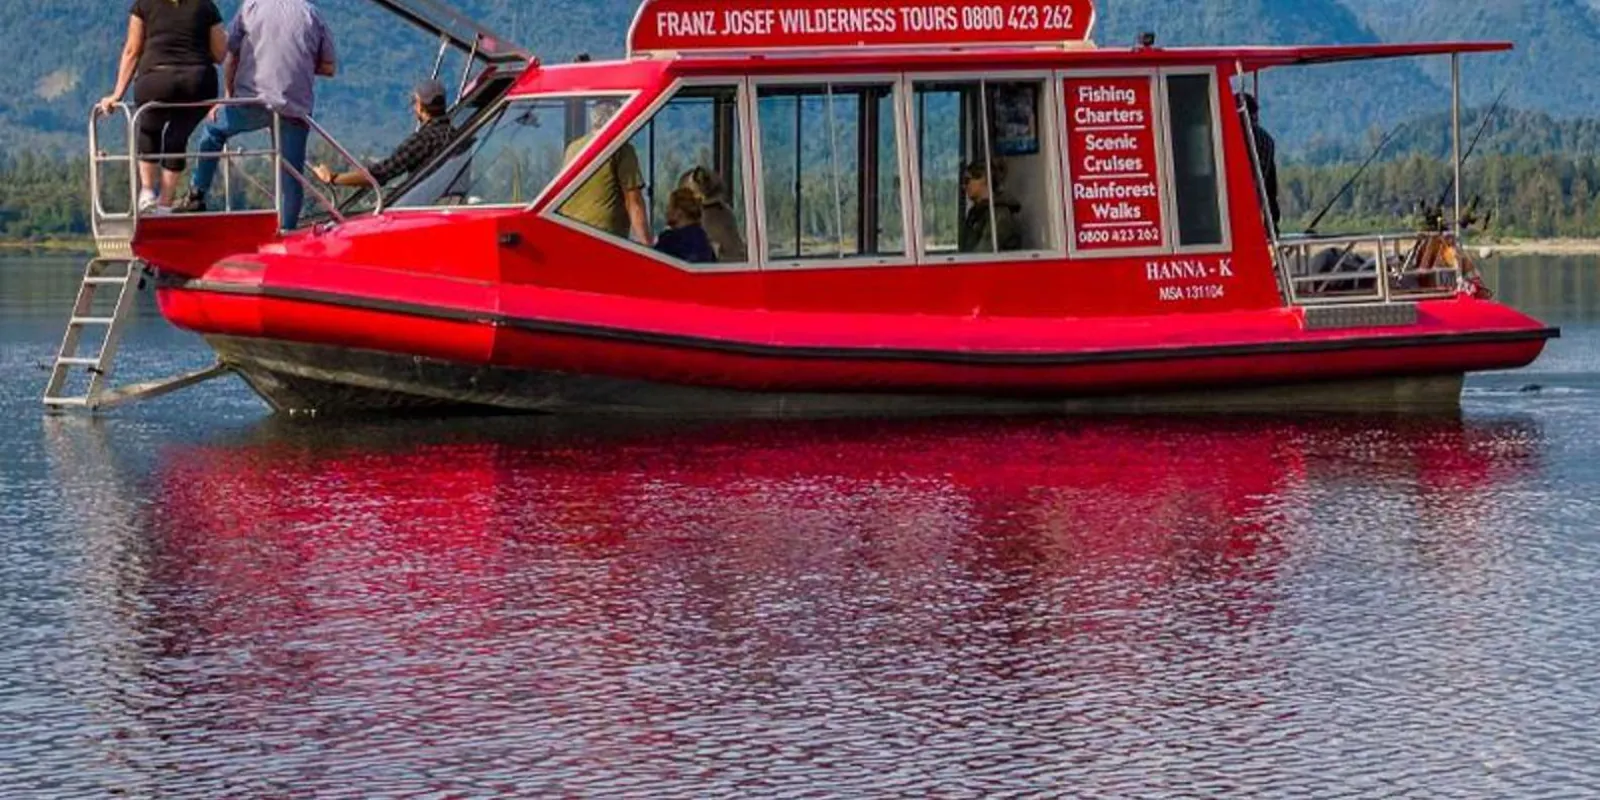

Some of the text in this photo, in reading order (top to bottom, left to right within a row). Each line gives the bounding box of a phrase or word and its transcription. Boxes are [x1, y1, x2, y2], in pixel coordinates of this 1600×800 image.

[656, 5, 1074, 37] FRANZ JOSEF WILDERNESS TOURS 0800 423 262
[1078, 86, 1136, 105] Fishing
[1074, 107, 1144, 124] Charters
[1085, 133, 1138, 151] Scenic
[1083, 155, 1143, 173] Cruises
[1073, 181, 1157, 200] Rainforest
[1091, 202, 1141, 220] Walks
[1079, 228, 1160, 243] 0800 423 262
[1146, 261, 1207, 280] HANNA
[1159, 286, 1184, 301] MSA
